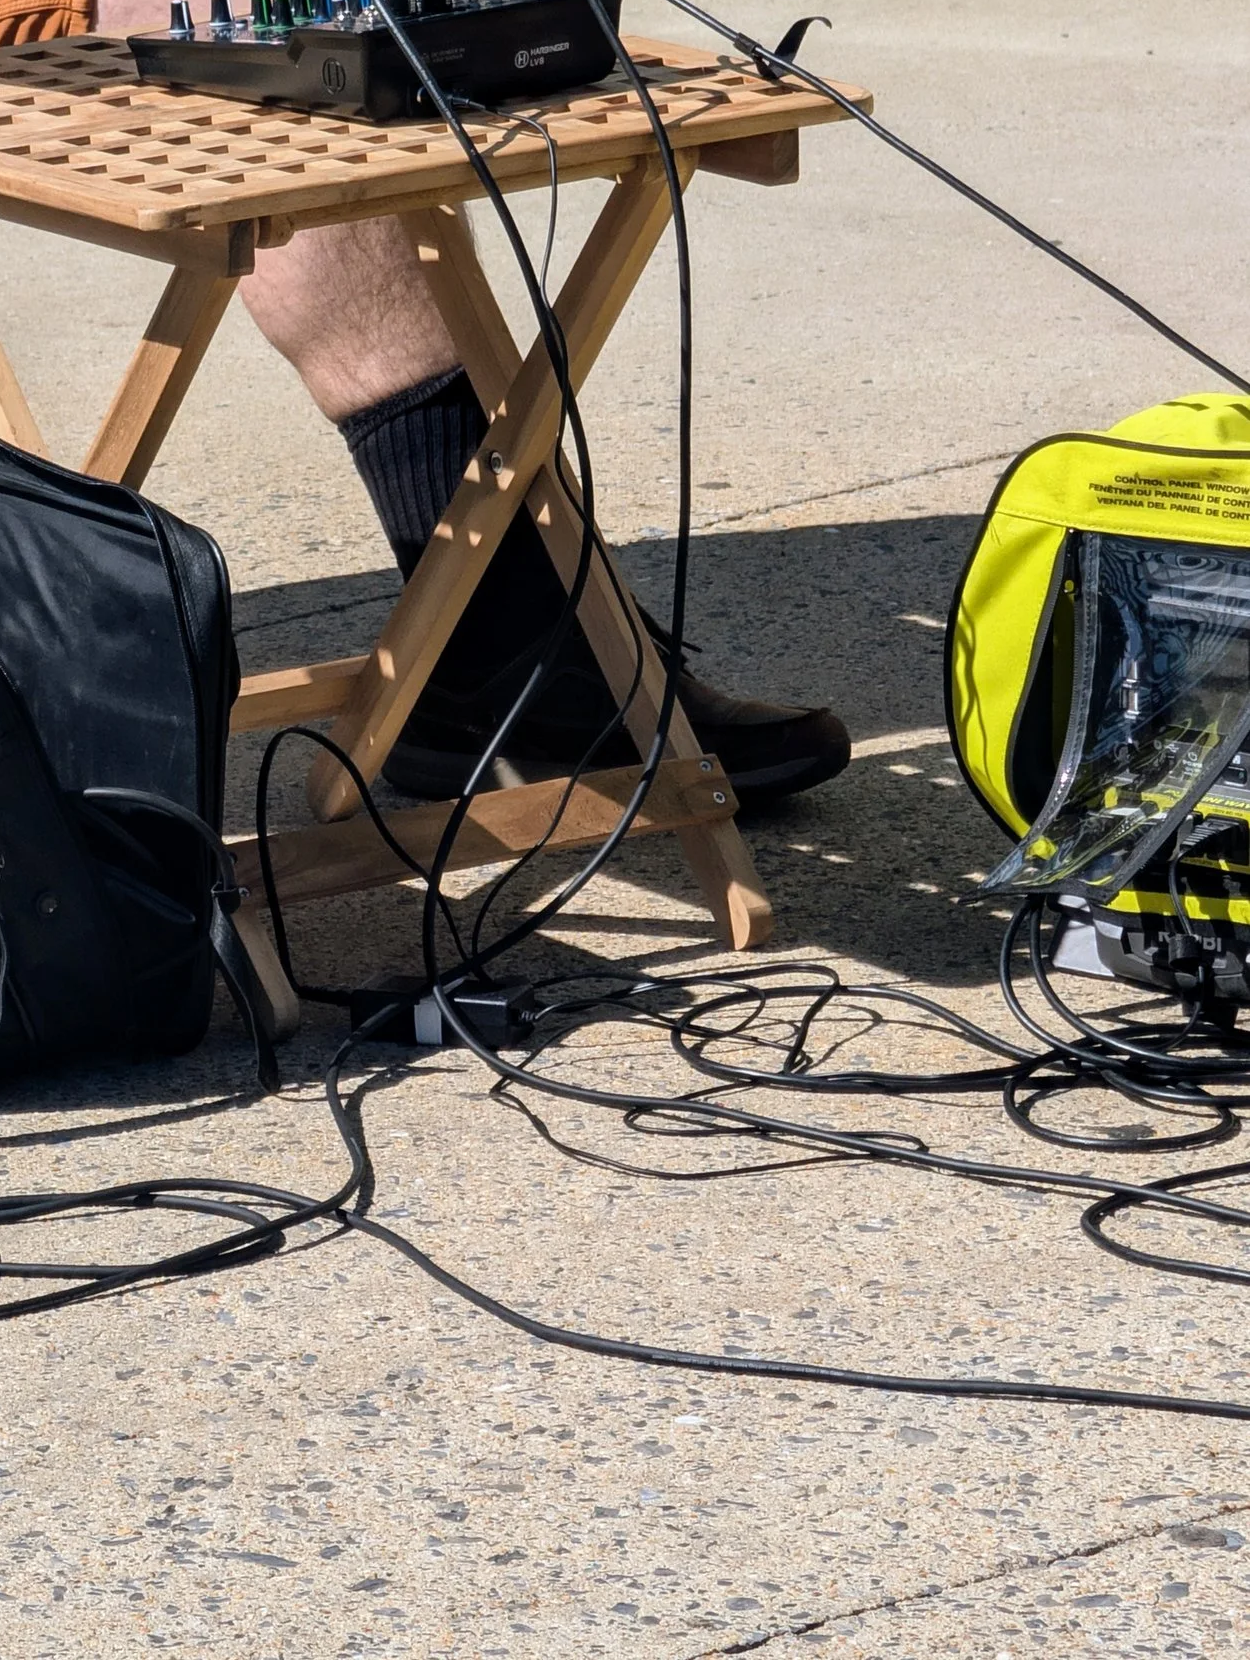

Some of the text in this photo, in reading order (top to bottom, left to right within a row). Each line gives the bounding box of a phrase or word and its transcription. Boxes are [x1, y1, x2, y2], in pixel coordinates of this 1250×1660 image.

[1114, 475, 1250, 495] CONTROL PANEL WINDOW
[1096, 496, 1145, 508] VENTANA
[1147, 501, 1167, 510] DEL
[1169, 503, 1203, 515] PANEL
[1205, 507, 1220, 517] DE
[1136, 488, 1152, 497] DU
[1154, 490, 1205, 502] PANNEAU
[1207, 495, 1221, 505] DE
